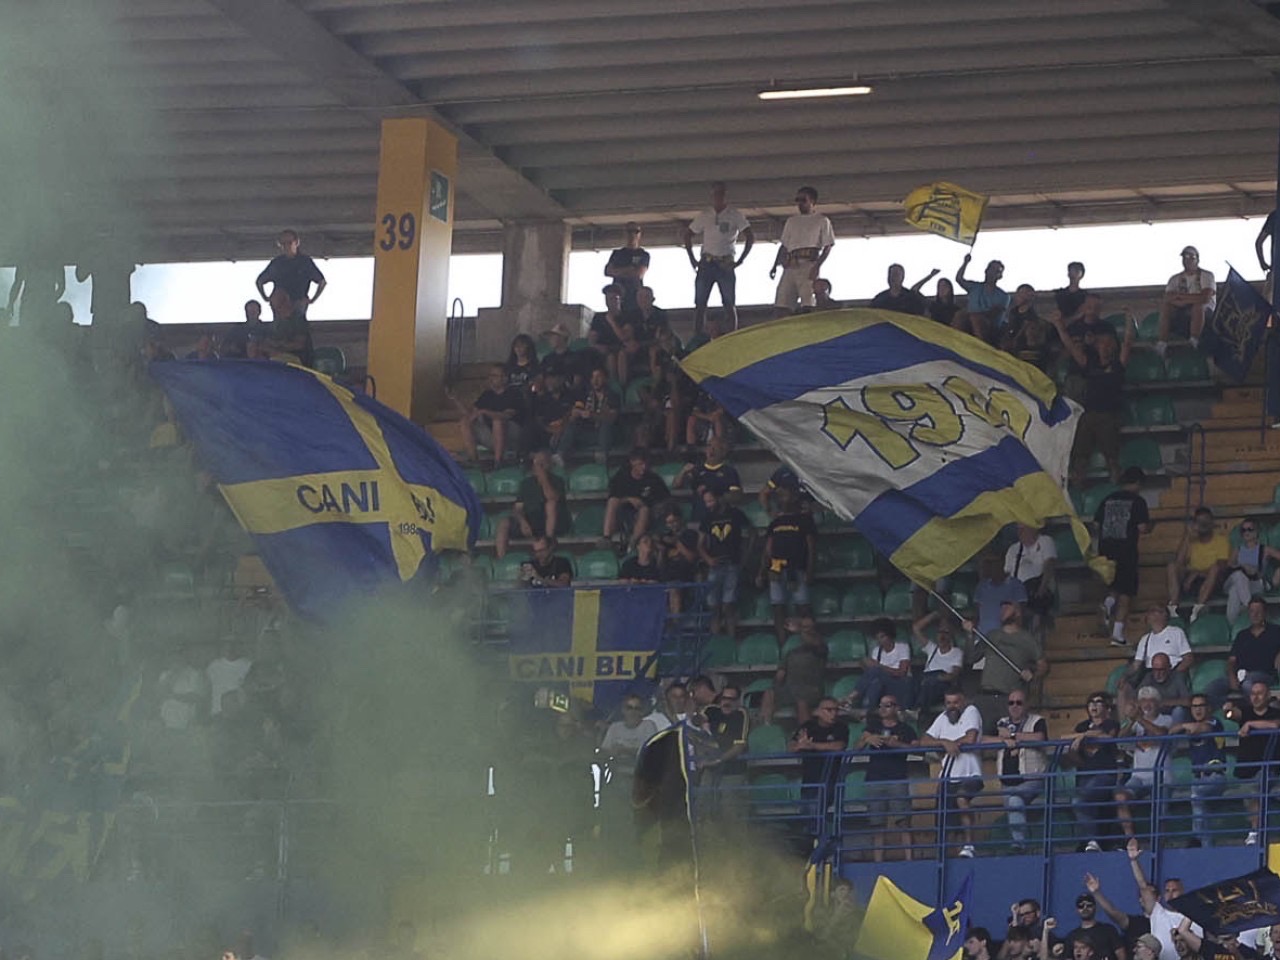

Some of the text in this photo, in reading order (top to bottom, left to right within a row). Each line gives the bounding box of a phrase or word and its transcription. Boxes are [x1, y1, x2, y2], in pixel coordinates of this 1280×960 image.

[380, 212, 416, 252] 39
[296, 481, 381, 514] CANI
[516, 656, 585, 679] CANI
